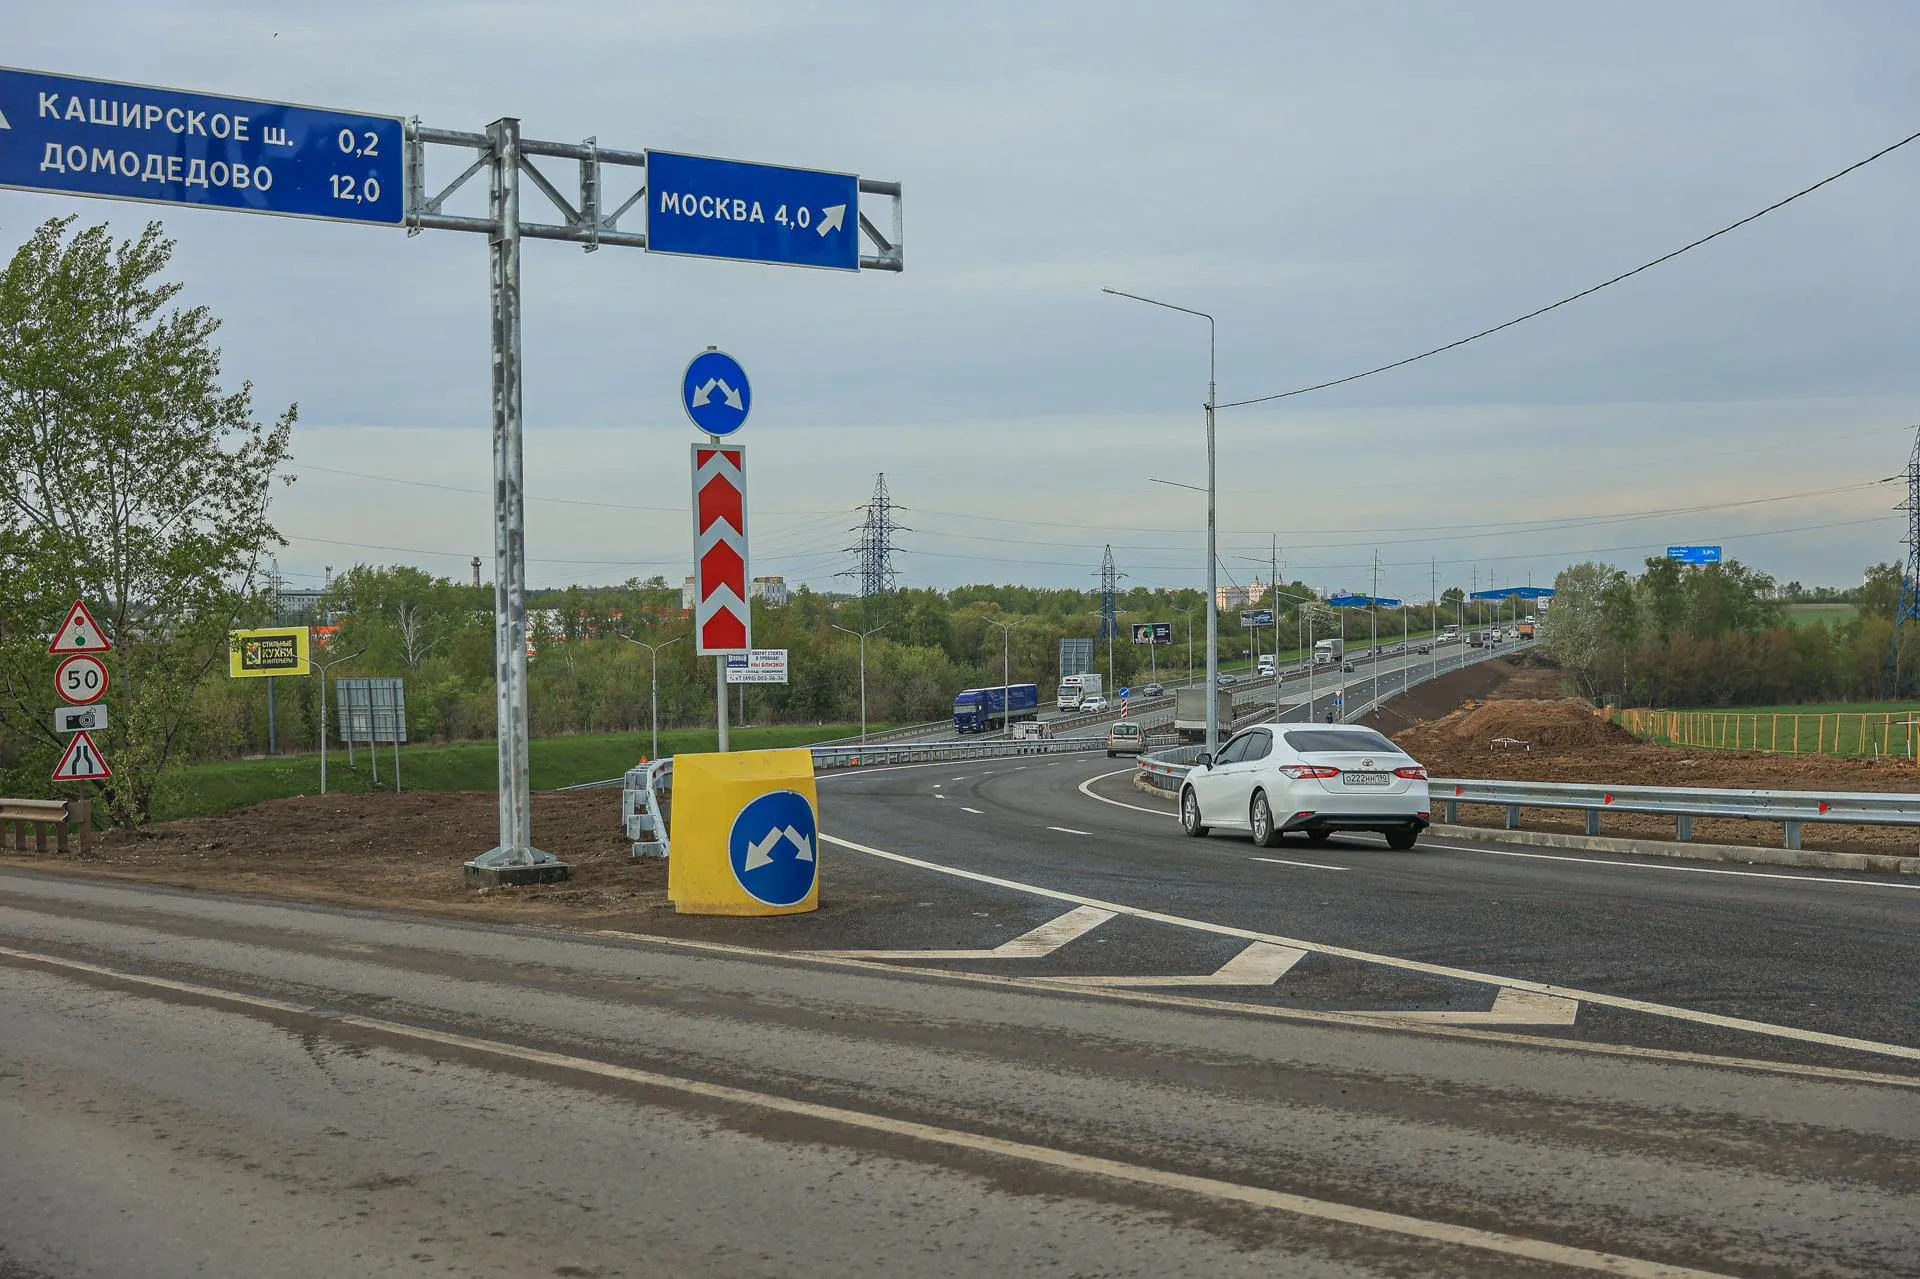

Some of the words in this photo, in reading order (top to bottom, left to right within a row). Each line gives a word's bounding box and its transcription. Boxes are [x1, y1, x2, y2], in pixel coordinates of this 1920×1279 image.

[38, 91, 250, 142] КАШИРСКОЕ
[263, 126, 295, 147] ш.
[338, 128, 379, 158] 0,2
[40, 142, 273, 192] ДОМОДЕДОВО
[330, 174, 380, 205] 12,0
[660, 191, 765, 224] МОСКВА
[774, 204, 811, 230] 4,0
[262, 640, 293, 648] СТИЛЬНЫЕ
[262, 648, 293, 658] КУХНИ
[68, 669, 98, 689] 50
